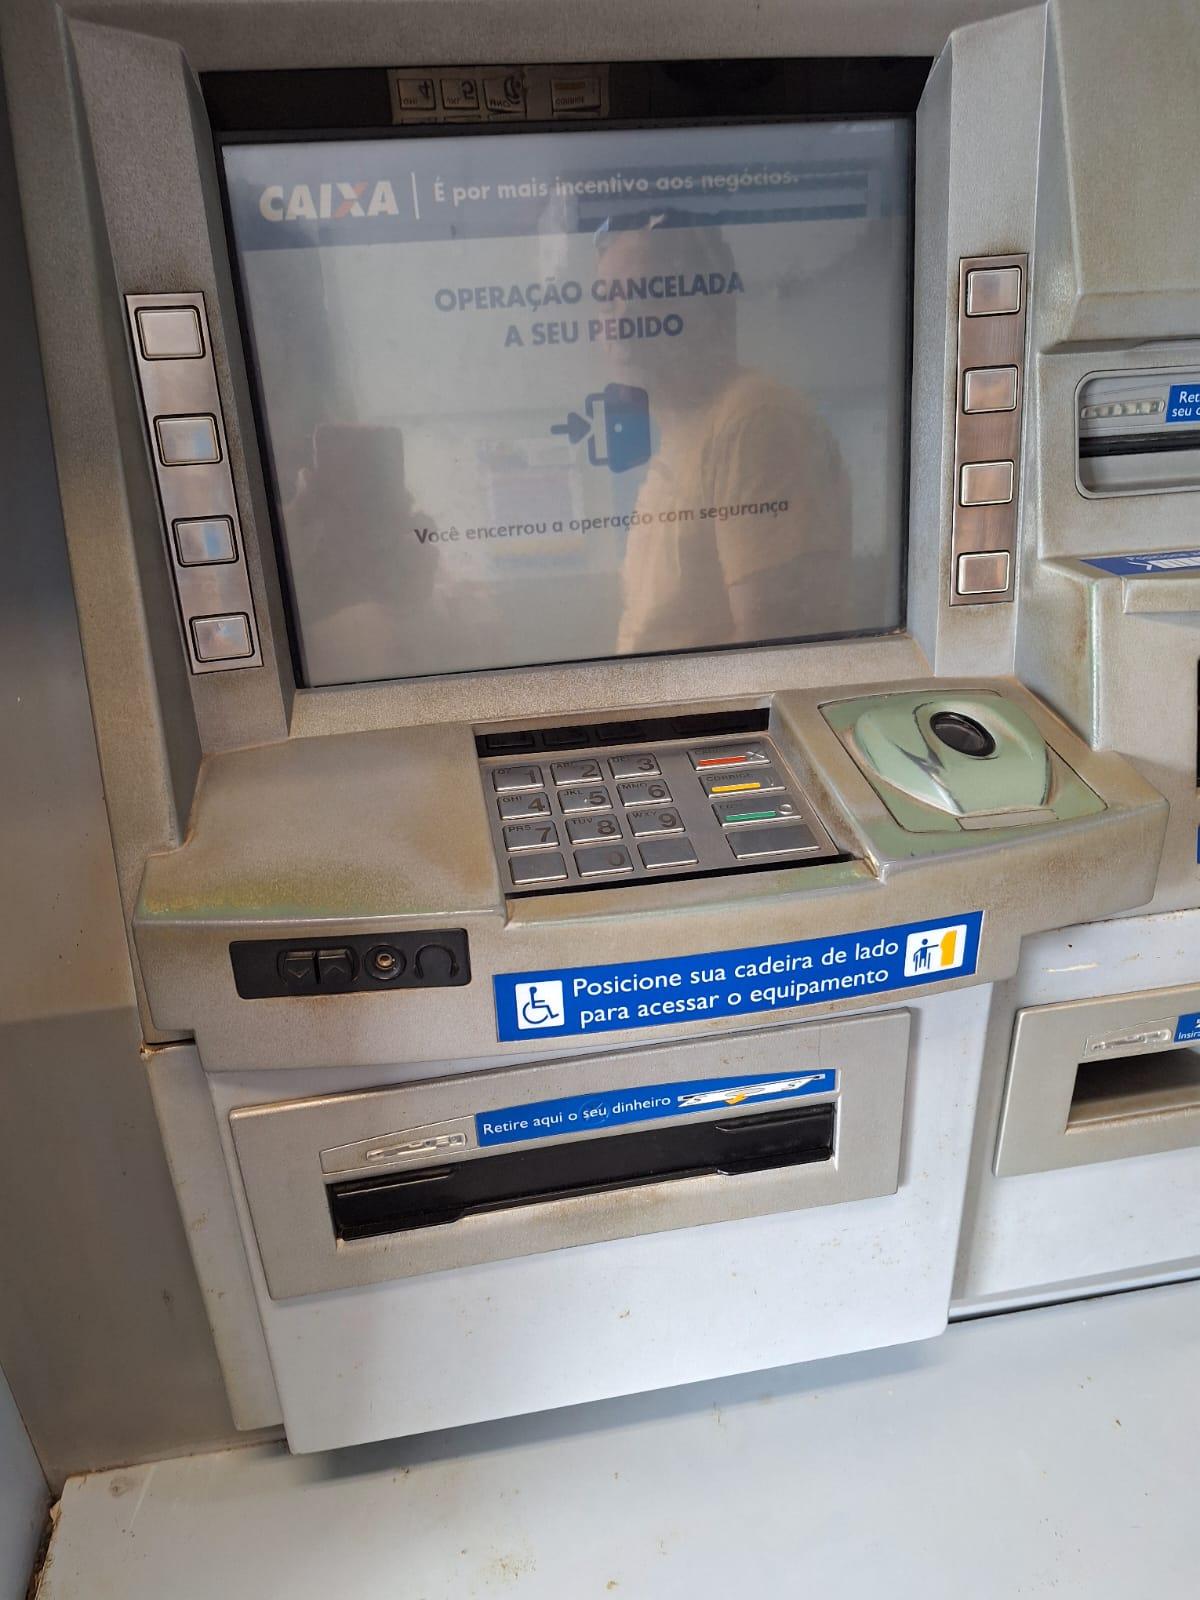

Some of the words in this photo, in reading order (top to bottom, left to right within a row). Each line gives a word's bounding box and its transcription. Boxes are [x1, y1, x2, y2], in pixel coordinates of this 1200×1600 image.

[434, 176, 446, 202] É
[453, 183, 490, 207] por
[497, 177, 547, 198] mais
[555, 173, 649, 196] incentivo
[656, 172, 694, 190] aos
[701, 167, 799, 192] negócios.
[259, 180, 400, 222] CAIXA
[434, 276, 582, 312] OPERAÇÃO
[591, 271, 745, 302] CANCELADA
[504, 324, 524, 347] A
[532, 320, 579, 347] SEU
[588, 313, 684, 342] PEDIDO
[1171, 407, 1192, 417] seu
[414, 527, 460, 545] Você
[465, 521, 547, 541] encerrou
[552, 521, 563, 533] a
[569, 510, 653, 534] operação
[658, 507, 695, 523] com
[700, 499, 789, 521] segurança
[582, 764, 598, 777] 2
[637, 759, 654, 771] 3
[524, 769, 537, 784] 1
[590, 791, 606, 805] 5
[647, 785, 665, 798] 6
[528, 798, 546, 812] 4
[597, 820, 616, 835] 8
[659, 812, 676, 828] 9
[535, 827, 551, 843] 7
[573, 974, 682, 997] Posicione
[690, 967, 726, 984] sua
[735, 955, 813, 978] cadeira
[821, 947, 847, 966] de
[855, 939, 899, 961] lado
[580, 1005, 630, 1029] para
[638, 994, 719, 1017] acessar
[727, 992, 742, 1006] o
[750, 969, 889, 1005] equipamento
[483, 1120, 528, 1135] Retire
[533, 1111, 563, 1129] aqui
[568, 1112, 578, 1121] o
[583, 1107, 607, 1119] seu
[612, 1097, 671, 1114] dinheiro
